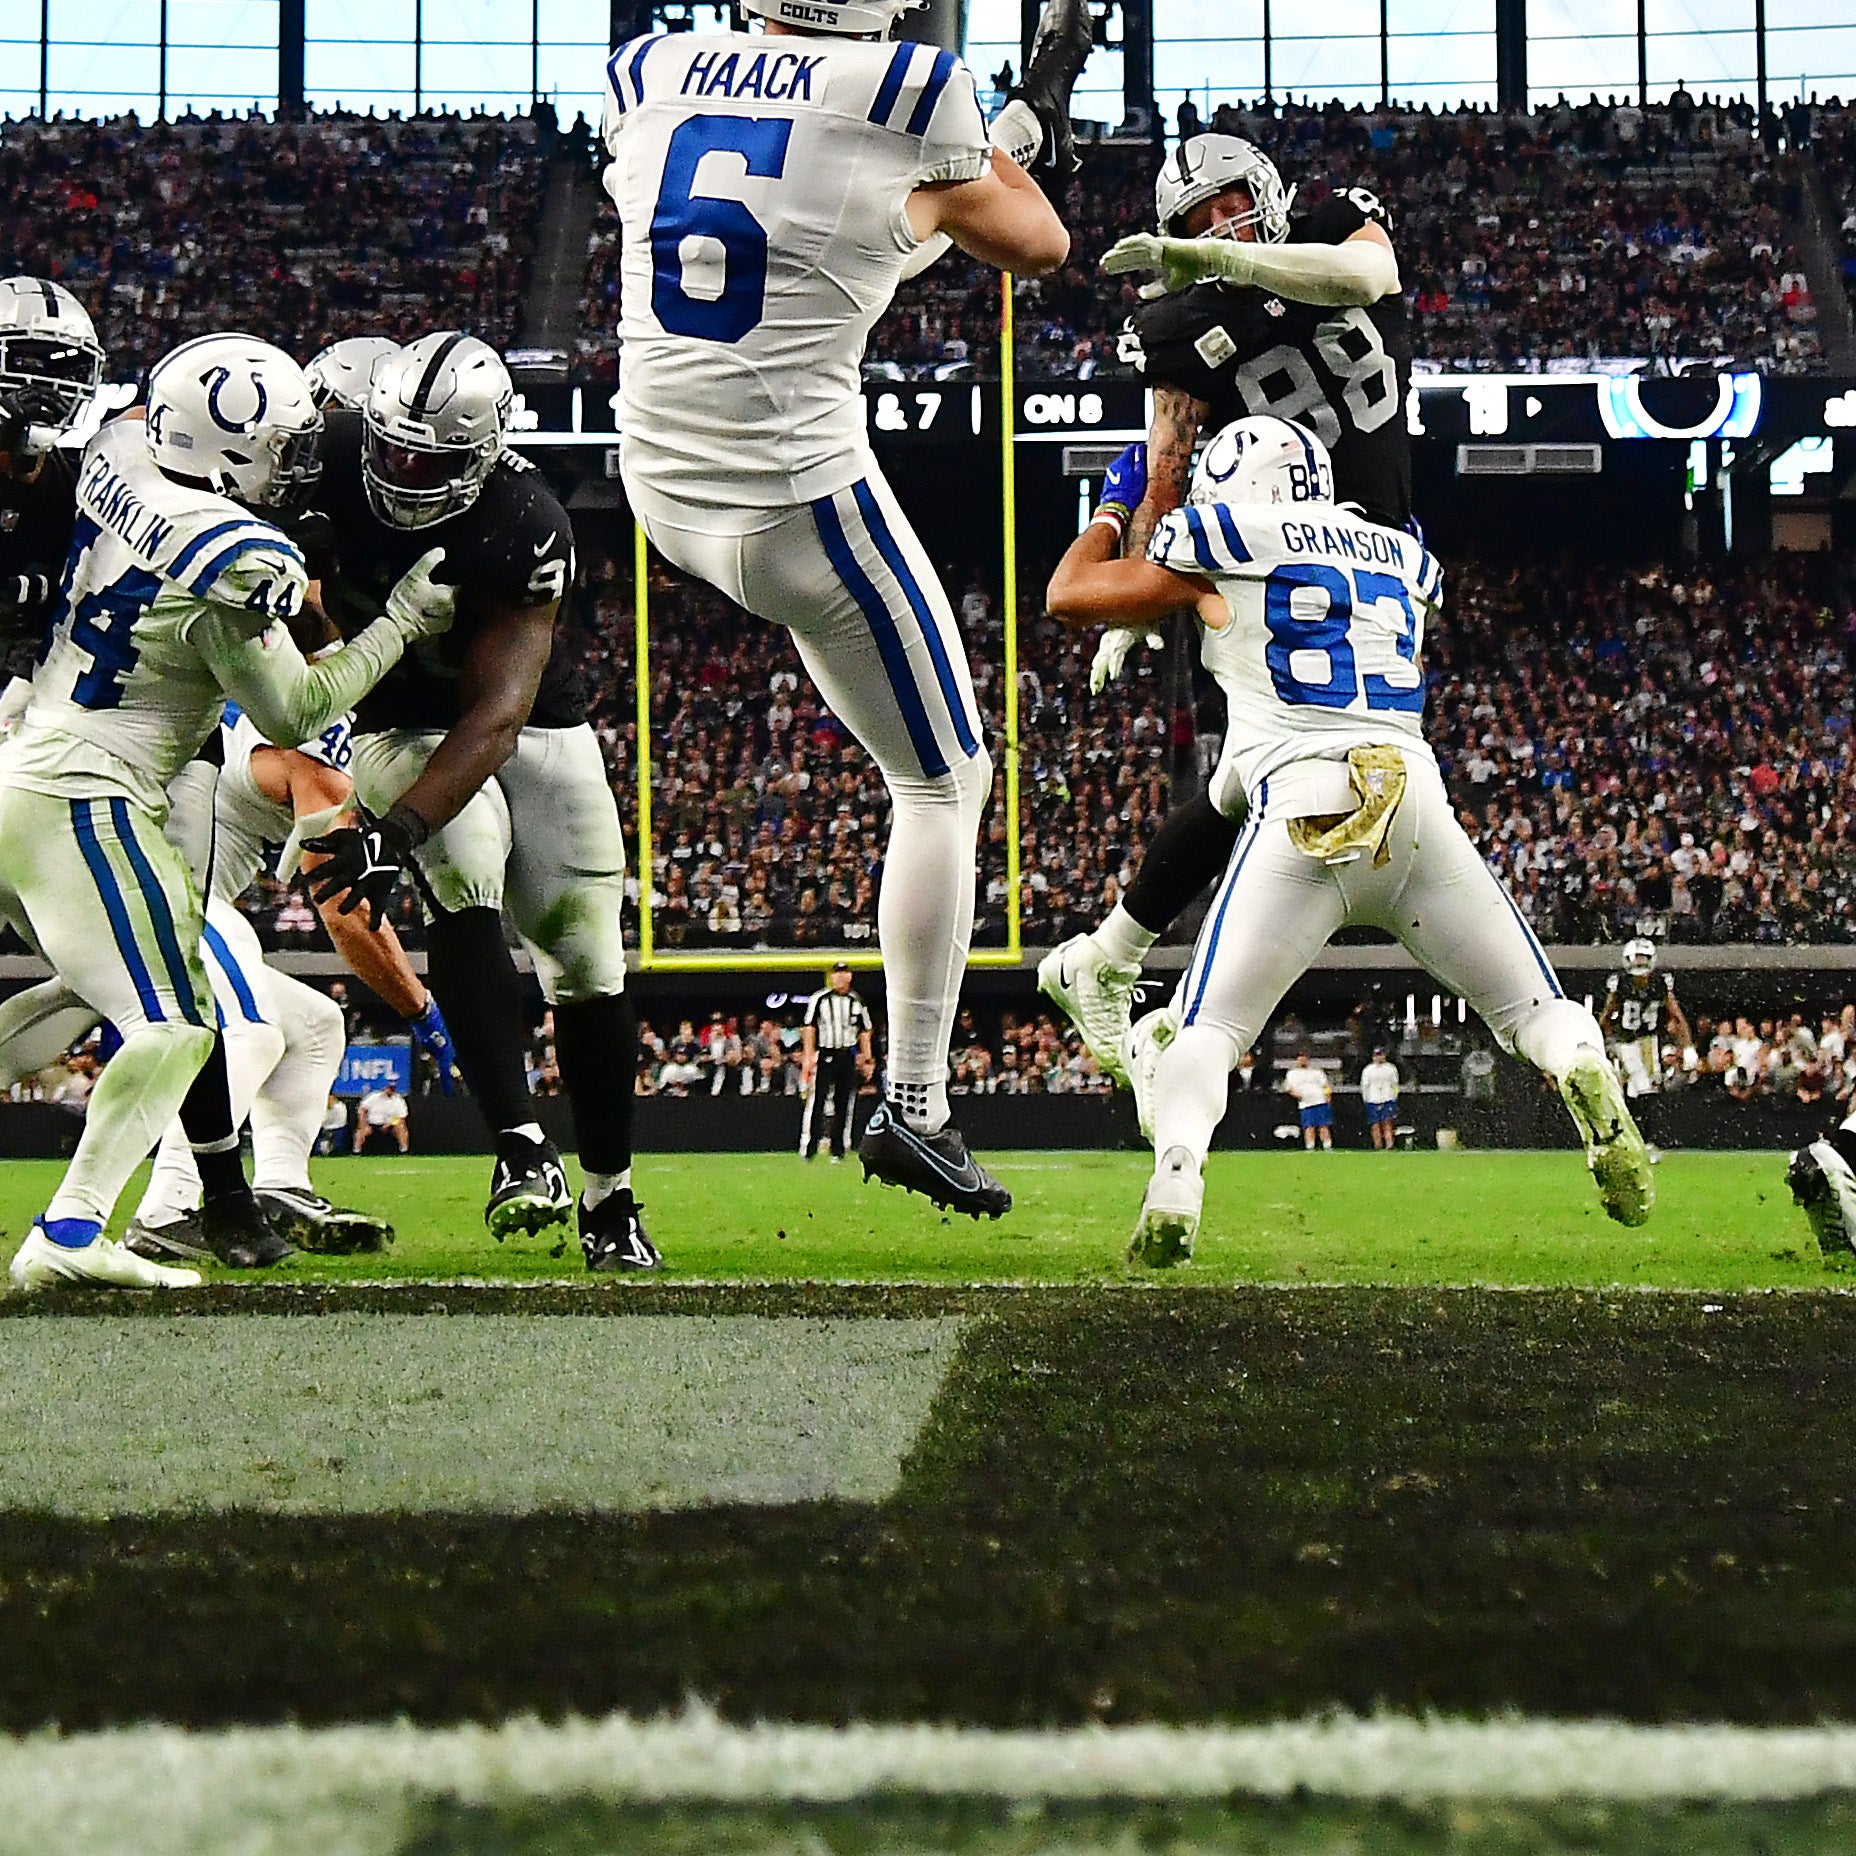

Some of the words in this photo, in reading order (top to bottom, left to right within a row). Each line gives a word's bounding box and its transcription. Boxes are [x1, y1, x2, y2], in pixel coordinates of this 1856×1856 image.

[780, 1, 839, 25] COLTS
[680, 52, 827, 101] HAACK
[650, 114, 794, 344] 6
[1236, 307, 1398, 448] 98
[915, 395, 943, 431] 7
[1024, 394, 1076, 424] ON
[1078, 394, 1104, 424] 8
[85, 452, 174, 561] FRANKLIN
[1282, 522, 1405, 570] GRANSON
[245, 579, 297, 618] 44
[1265, 563, 1425, 714] 83
